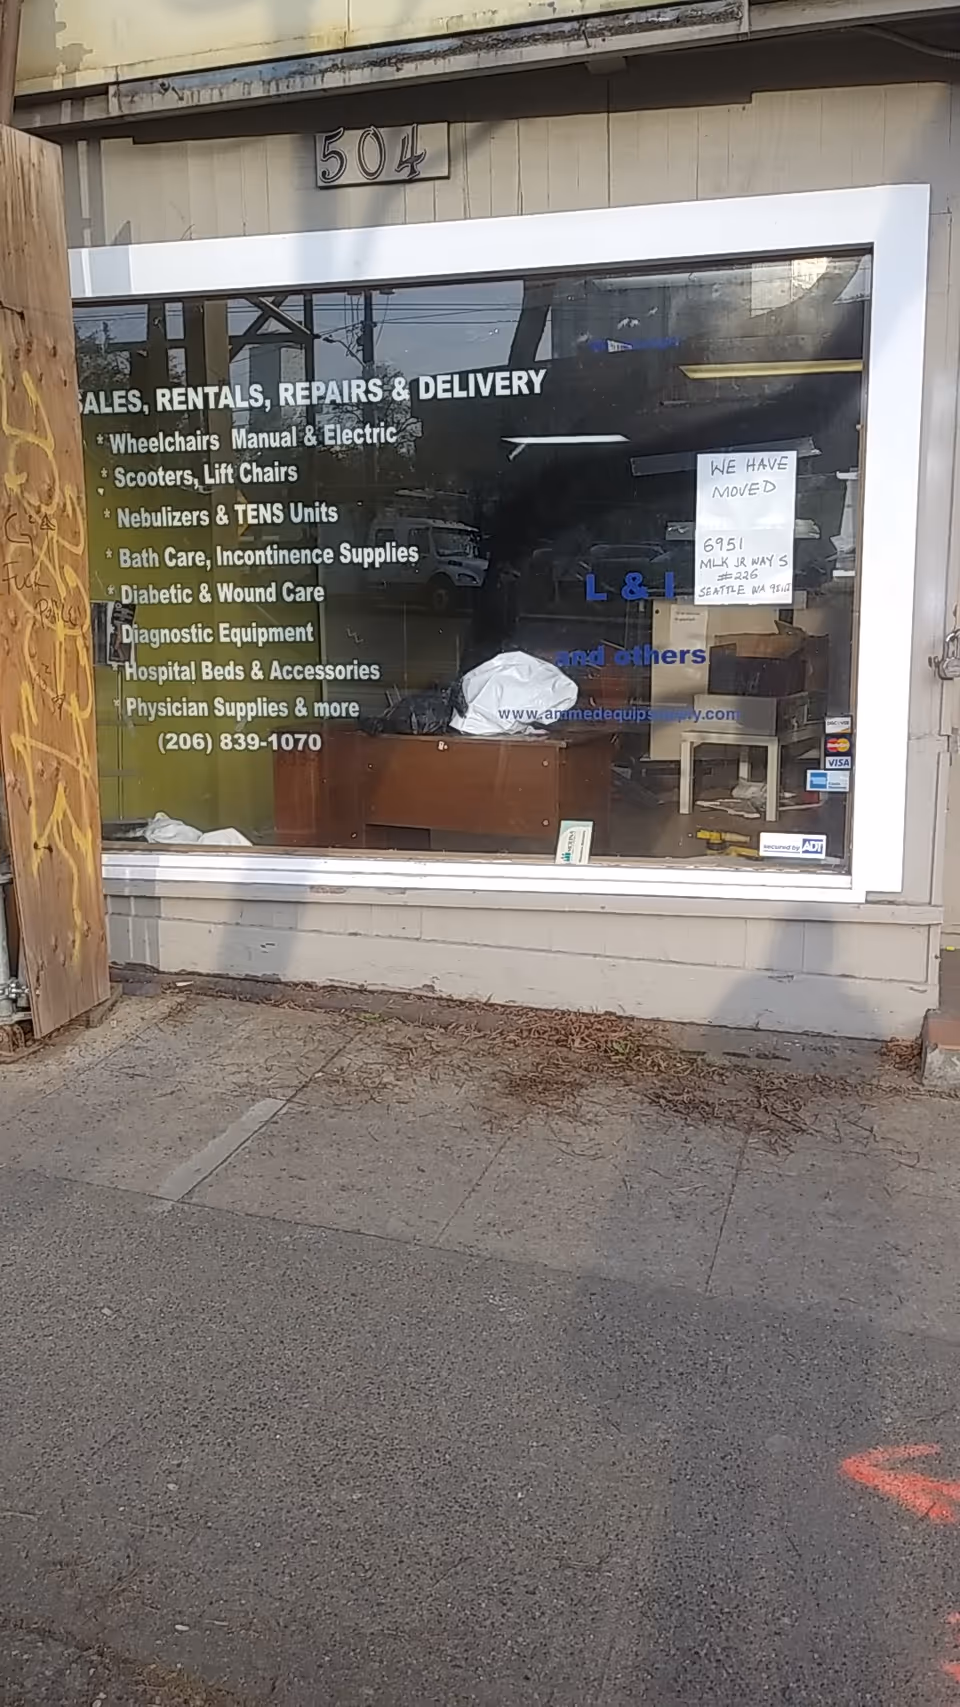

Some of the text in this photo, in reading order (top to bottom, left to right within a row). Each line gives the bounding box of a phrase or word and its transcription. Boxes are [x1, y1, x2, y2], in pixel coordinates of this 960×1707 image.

[319, 124, 427, 183] 504
[155, 384, 272, 412] RENTALS,
[279, 378, 383, 406] REPAIRS
[391, 377, 411, 401] &
[419, 369, 547, 399] DELIVERY
[109, 422, 397, 455] Wheelchairs Manual & Electric
[114, 462, 298, 489] Scooters, Lift Chairs
[710, 455, 789, 476] WE HAVE
[712, 479, 777, 499] MOVED
[117, 502, 338, 528] Nebulizers & TENS Units
[119, 542, 419, 571] Bath Care, Incontinence Supplies
[703, 537, 744, 553] 6951
[700, 554, 789, 570] MLK JR WAY S
[586, 571, 675, 601] L & I
[717, 569, 759, 582] #226
[120, 582, 325, 605] Diabetic & Wound Care
[752, 584, 766, 595] WA
[121, 622, 314, 649] Diagnostic Equipment
[554, 643, 706, 666] and others
[125, 660, 381, 686] Hospital Beds & Accessories
[126, 697, 360, 721] Physician Supplies & more
[157, 732, 322, 755] (206) 839-1070
[828, 759, 850, 767] VISA
[802, 839, 823, 853] ADT
